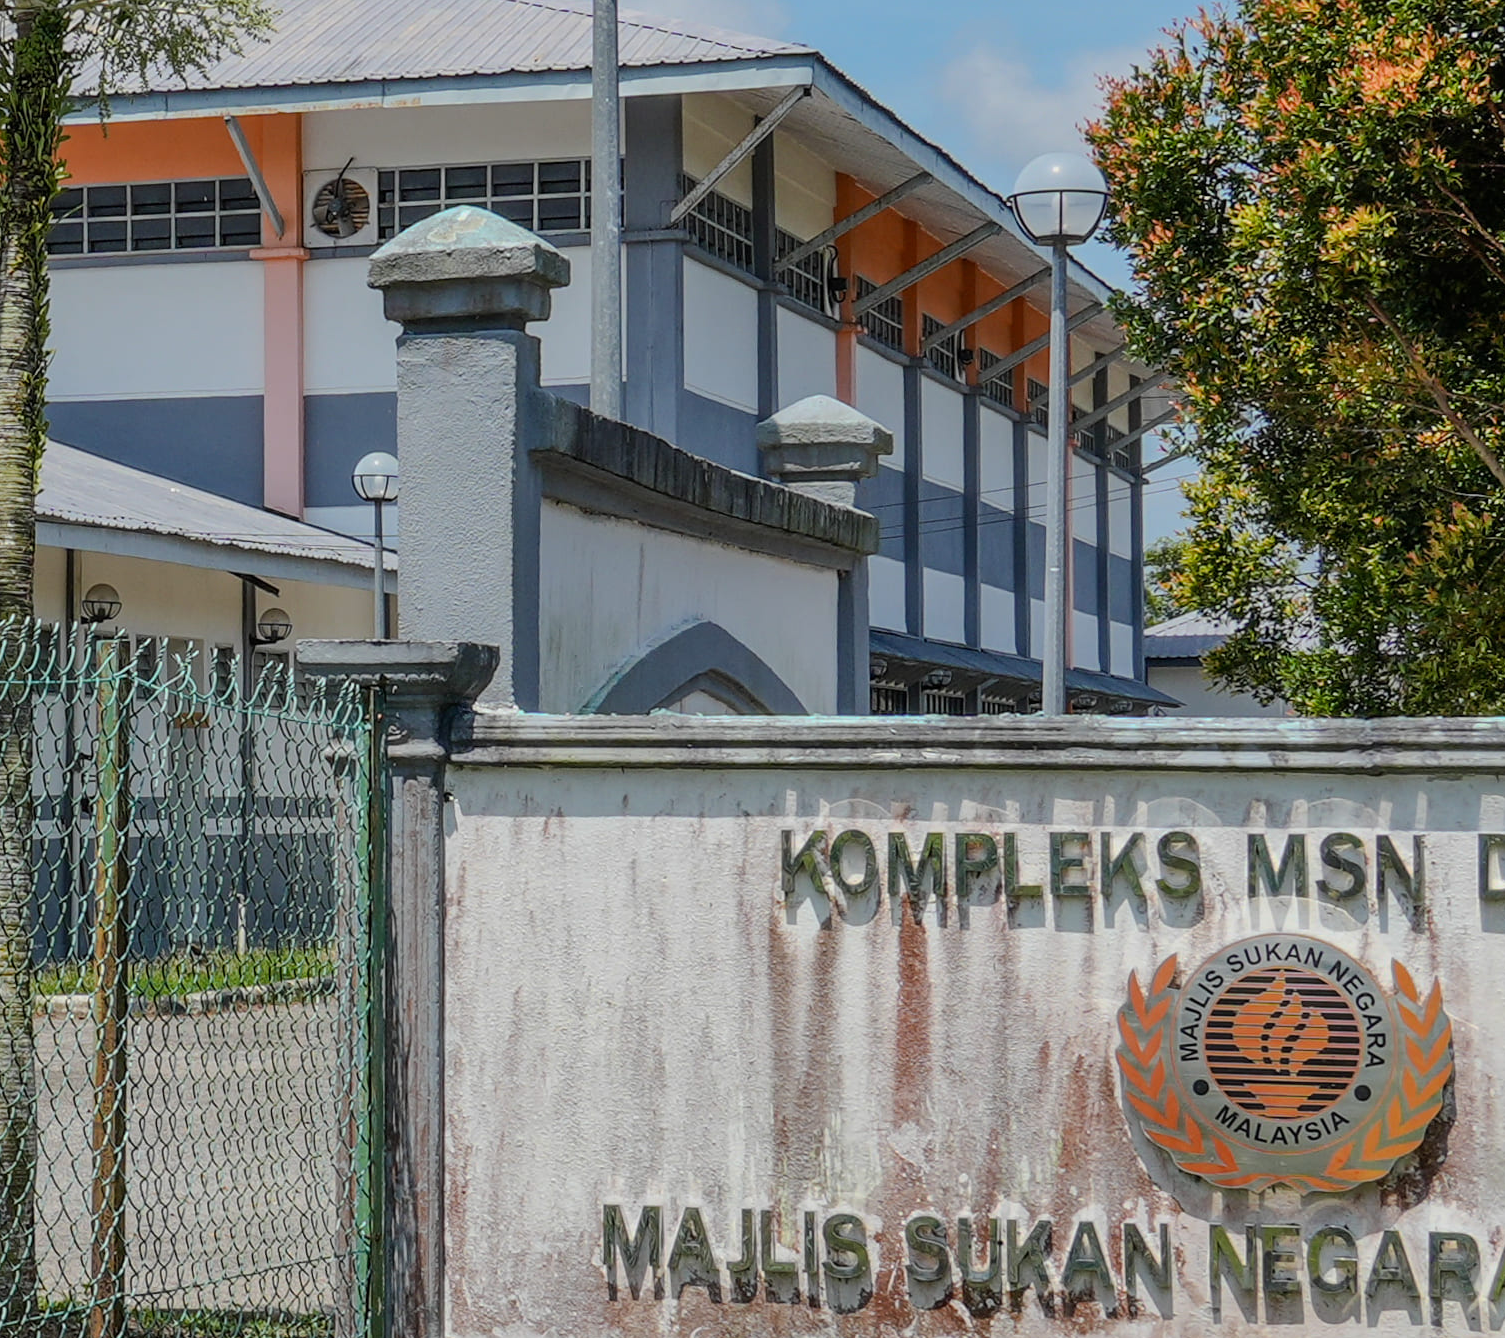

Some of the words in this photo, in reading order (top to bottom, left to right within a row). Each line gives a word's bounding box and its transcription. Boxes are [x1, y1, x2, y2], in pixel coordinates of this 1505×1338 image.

[780, 829, 1203, 898] KOMPLEKS
[1247, 831, 1428, 901] MSN
[1180, 970, 1224, 1063] MAJLIS
[1226, 942, 1324, 973] SUKAN
[1328, 959, 1386, 1069] NEGARA
[1214, 1104, 1351, 1145] MALAYSIA
[602, 1204, 872, 1278] MAJLIS
[904, 1214, 1173, 1288] SUKAN
